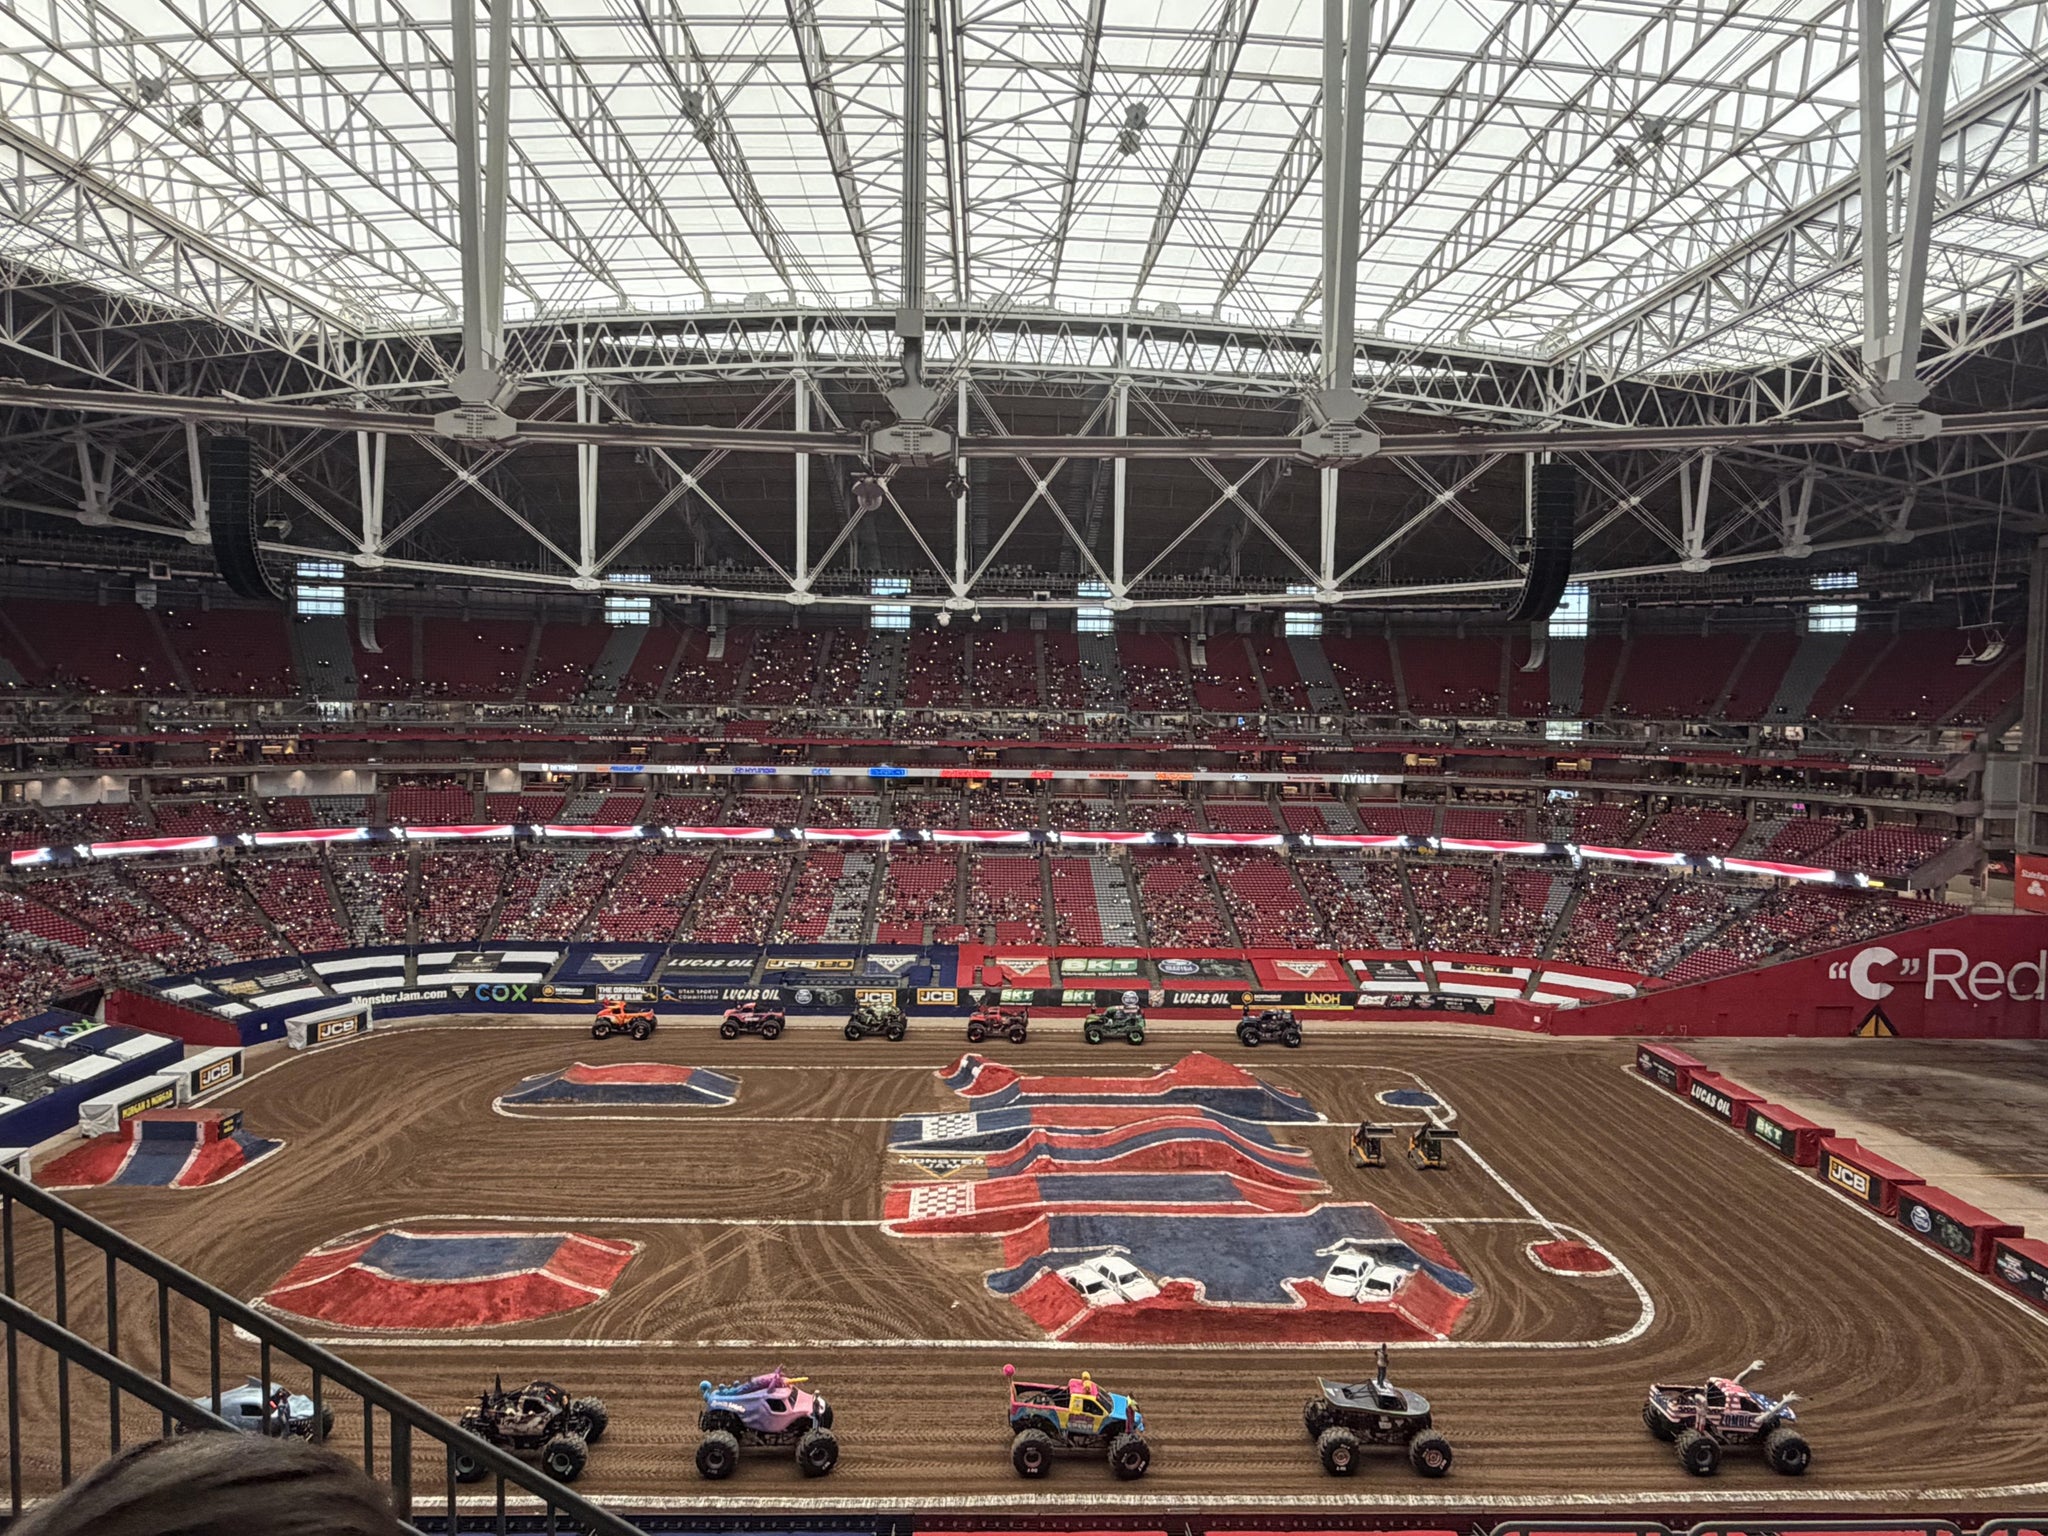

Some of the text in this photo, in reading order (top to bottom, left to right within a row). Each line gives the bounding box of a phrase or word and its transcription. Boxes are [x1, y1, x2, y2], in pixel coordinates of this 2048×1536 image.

[811, 768, 831, 776] COX
[1341, 774, 1380, 784] AVNET
[668, 958, 754, 968] LUCAS OIL
[1064, 959, 1137, 971] BKT
[1925, 948, 2047, 1001] Red
[475, 983, 528, 1002] COX
[598, 986, 646, 994] THE ORIGINAL
[722, 988, 781, 1001] LUCAS OIL
[920, 990, 954, 1001] JCB
[1001, 989, 1034, 1001] BKT
[1062, 990, 1096, 1002] BKT
[352, 988, 448, 1006] MonsterJam.com
[858, 991, 893, 1003] JCB
[1173, 992, 1229, 1005] LUCAS OIL
[1305, 993, 1341, 1004] UNOH
[44, 1019, 102, 1039] COX
[320, 1019, 356, 1037] JCB
[202, 1061, 232, 1085] JCB
[1690, 1082, 1732, 1117] LUCAS OIL
[1755, 1115, 1783, 1142] BKT
[898, 1157, 985, 1166] MONSTER
[1831, 1164, 1868, 1194] JCB
